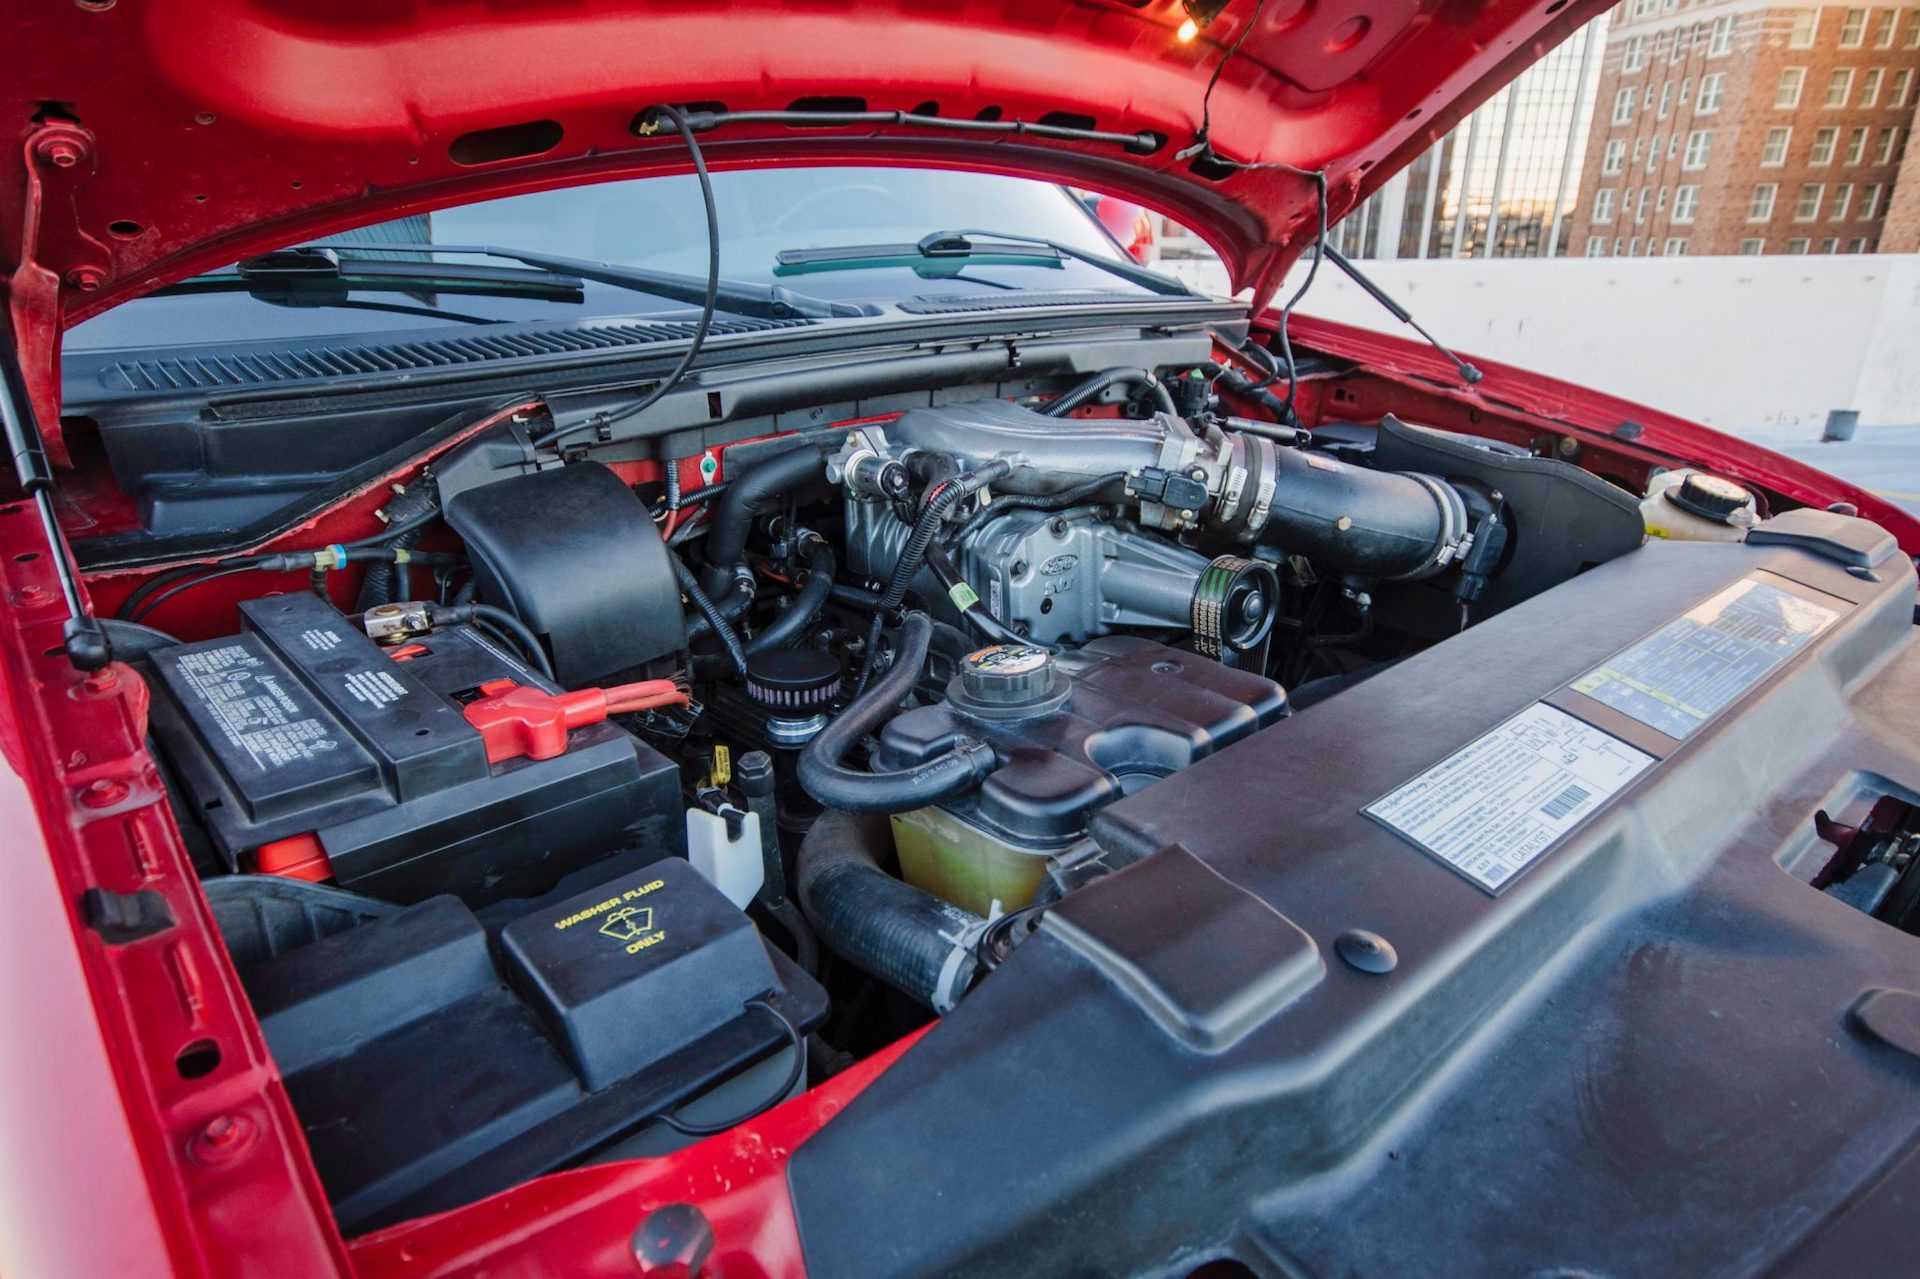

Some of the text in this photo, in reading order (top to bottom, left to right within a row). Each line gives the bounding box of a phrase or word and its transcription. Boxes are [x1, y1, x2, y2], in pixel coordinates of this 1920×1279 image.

[1043, 556, 1075, 575] Ford
[1044, 577, 1074, 596] SVT
[1511, 830, 1552, 862] CATALYST
[554, 879, 665, 930] WASHER FLUID
[626, 930, 666, 955] ONLY
